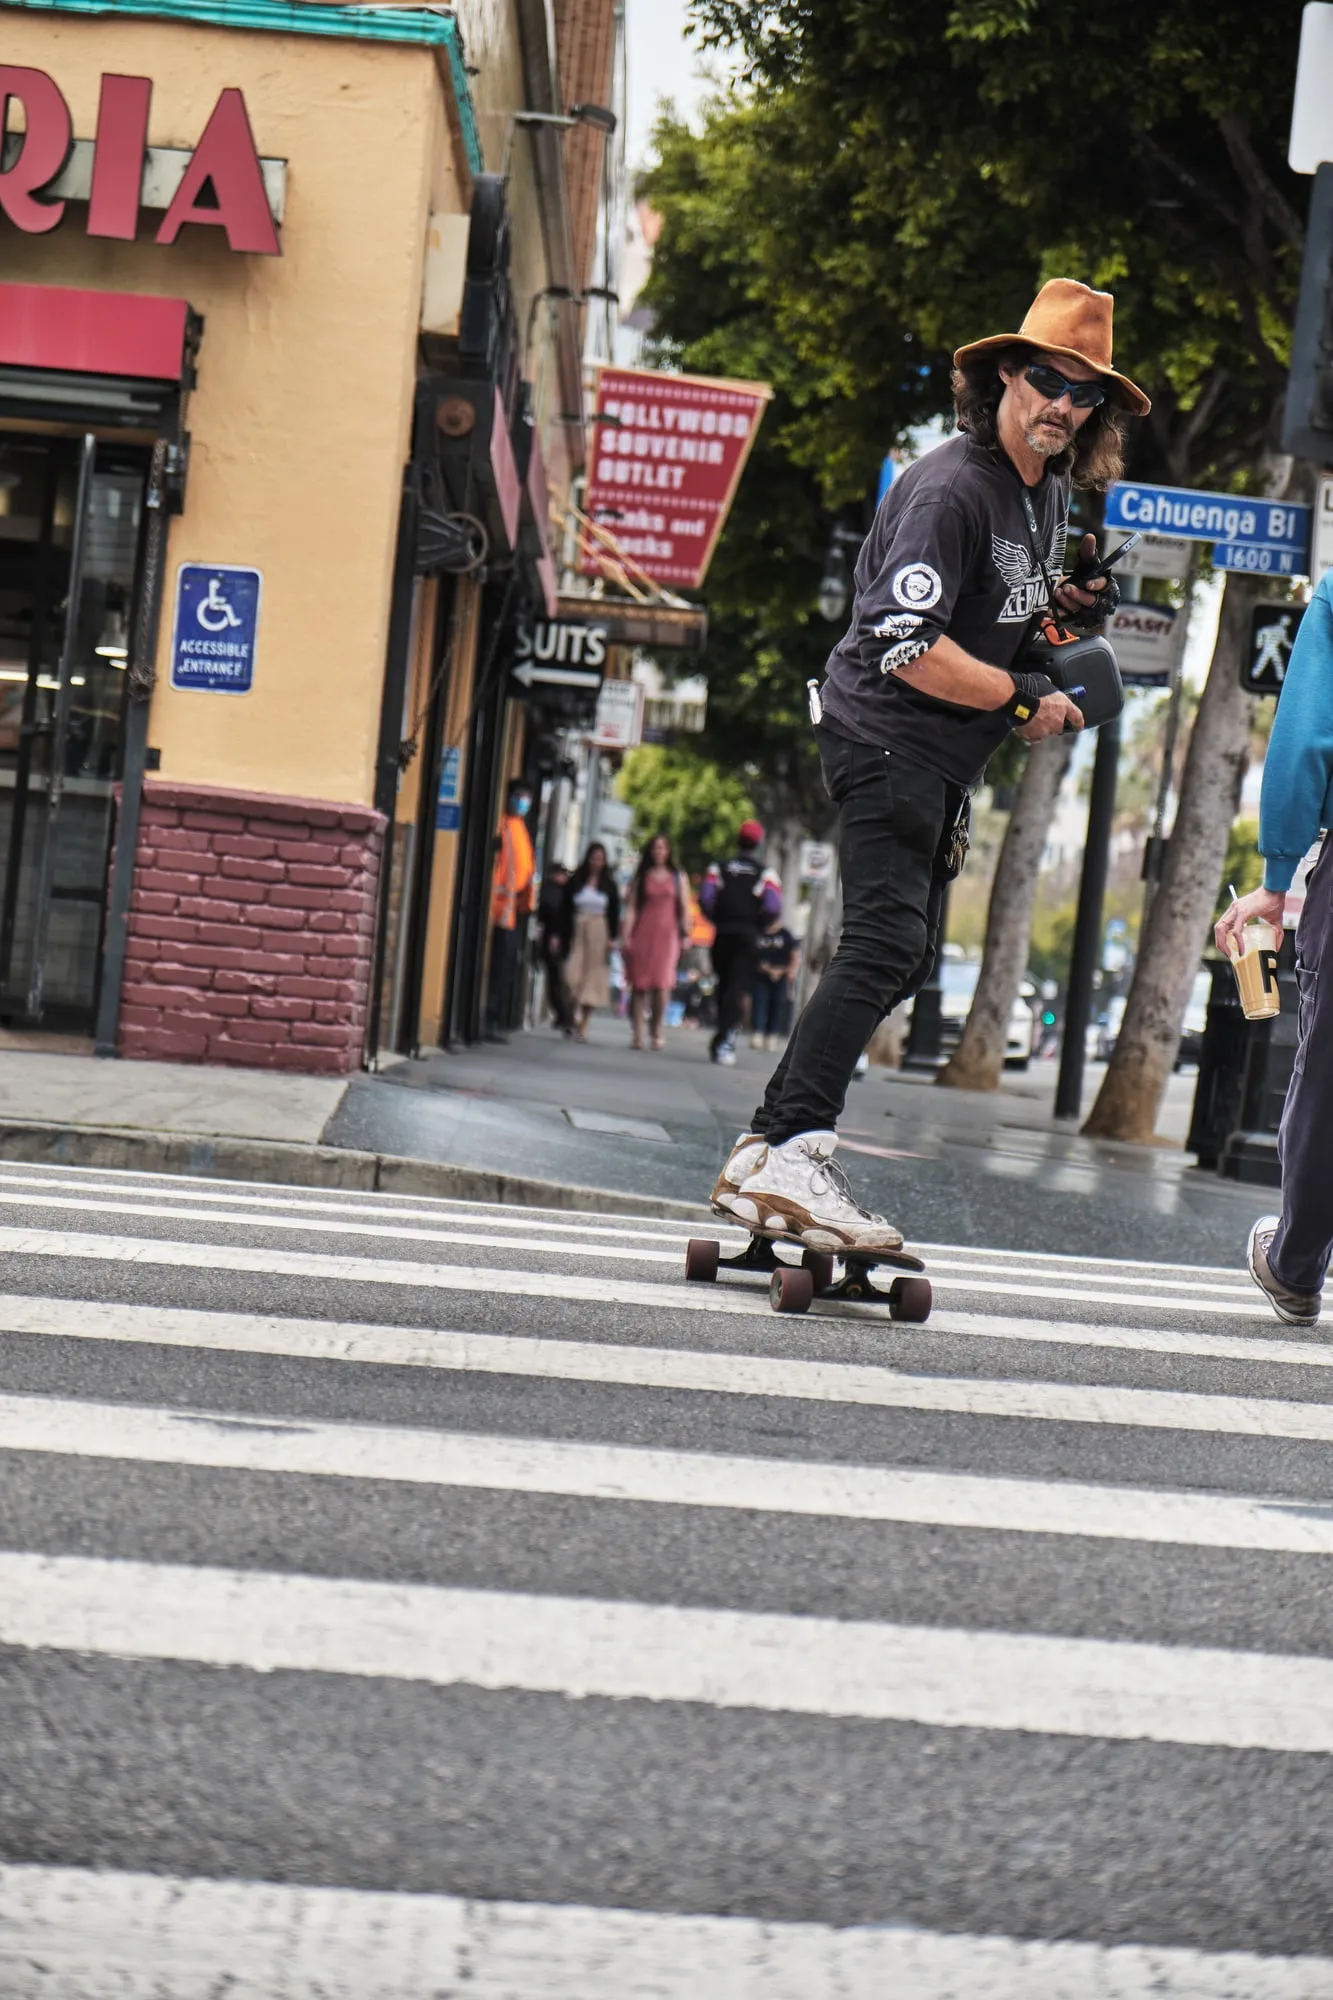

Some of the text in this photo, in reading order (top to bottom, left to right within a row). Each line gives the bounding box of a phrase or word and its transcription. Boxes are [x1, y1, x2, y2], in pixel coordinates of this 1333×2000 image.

[0, 65, 283, 256] RIA
[603, 401, 749, 438] HOLLYWOOD
[600, 430, 724, 465] SOUVENIR
[598, 458, 686, 490] OUTLET
[670, 518, 706, 537] and
[1119, 489, 1296, 540] Cahuenga Bl
[1226, 547, 1294, 572] 1600 N
[179, 640, 249, 658] ACCESSIBLE
[515, 622, 607, 666] SUITS
[183, 658, 242, 676] ENTRANCE
